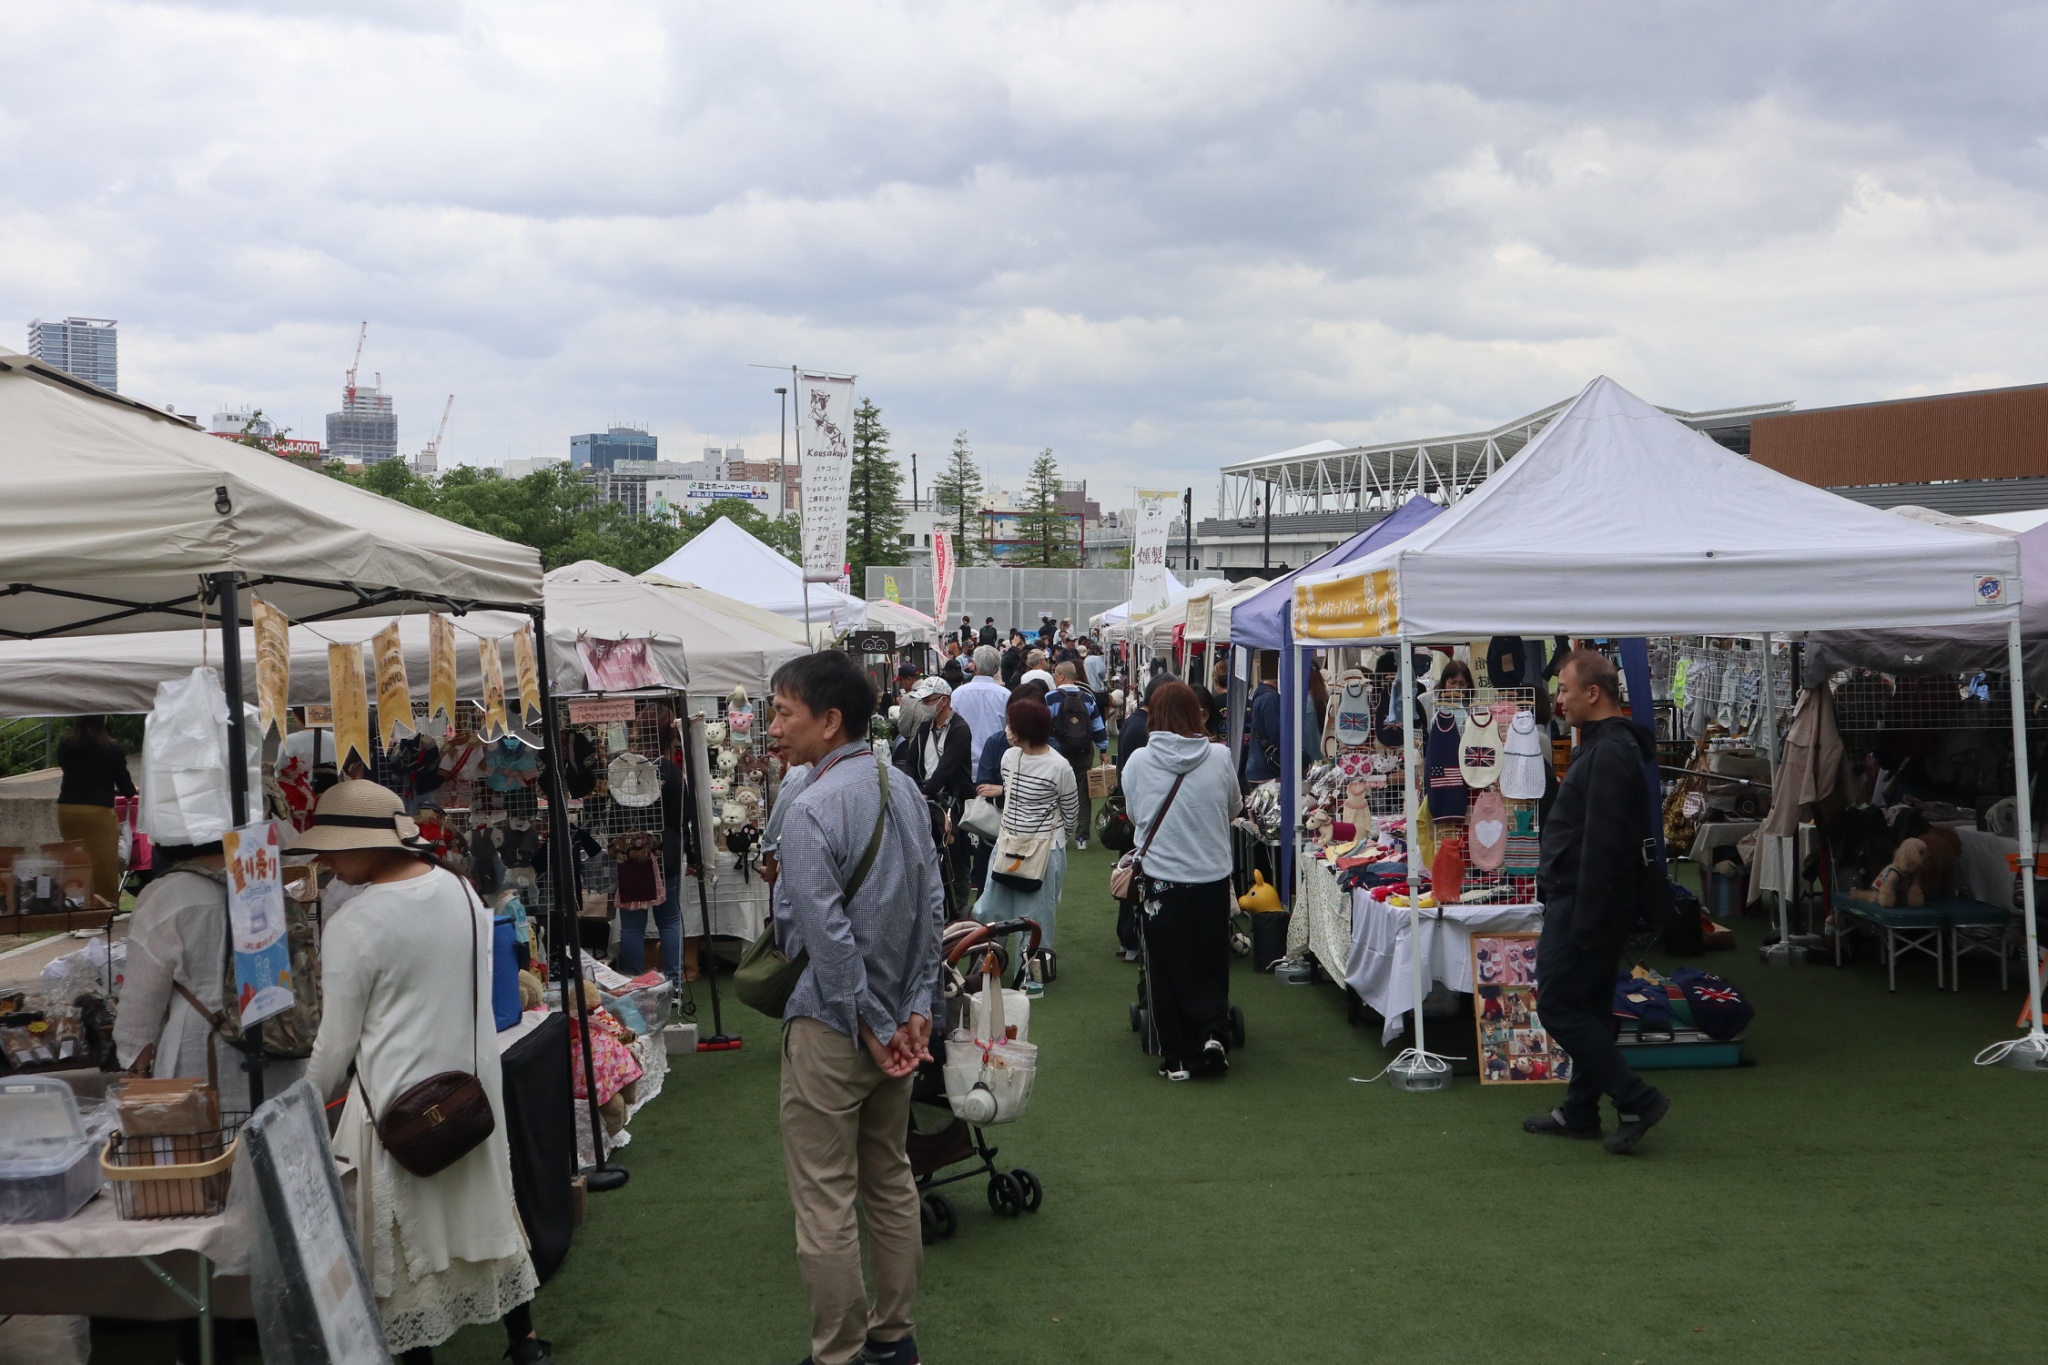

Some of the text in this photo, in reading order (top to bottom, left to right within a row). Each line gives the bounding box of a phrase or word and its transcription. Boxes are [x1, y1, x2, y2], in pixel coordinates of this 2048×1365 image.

[807, 448, 848, 461] Kousakuya
[697, 482, 750, 491] 富士ホームサービス
[1137, 545, 1162, 565] 燻製
[232, 848, 277, 895] 量り売り
